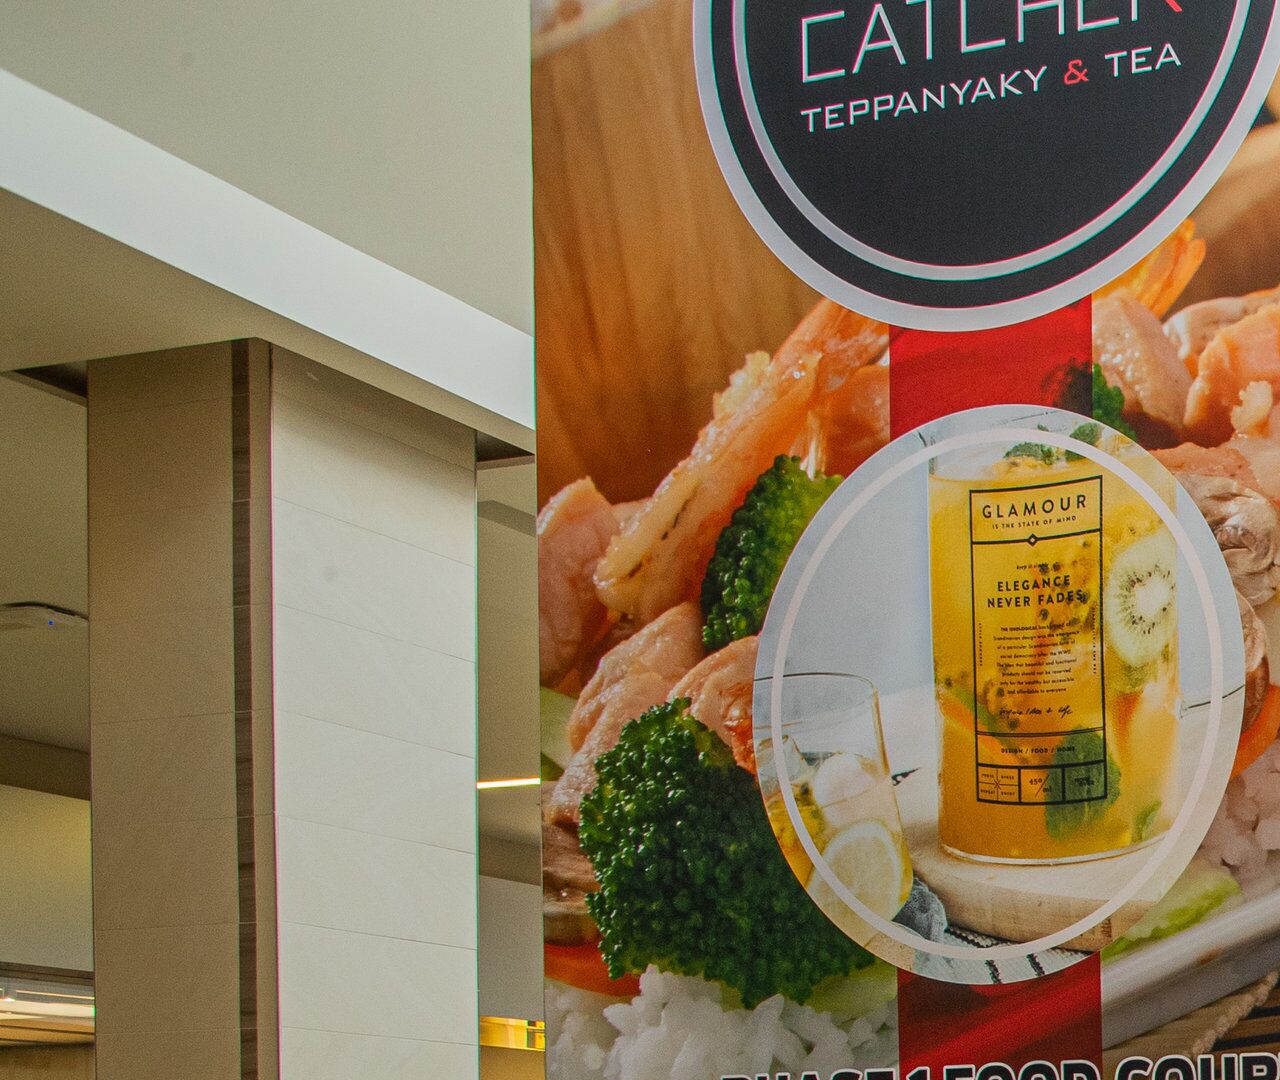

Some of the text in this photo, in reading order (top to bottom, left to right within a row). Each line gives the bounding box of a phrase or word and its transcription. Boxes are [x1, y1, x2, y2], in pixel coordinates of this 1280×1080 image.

[801, 0, 1182, 83] CATCH
[801, 43, 1181, 132] TEPPANYAKY & TEA
[982, 495, 1086, 518] GLAMOUR
[1018, 520, 1039, 528] STATE
[997, 575, 1070, 592] ELEGANCE
[987, 590, 1085, 608] NEVER FADES
